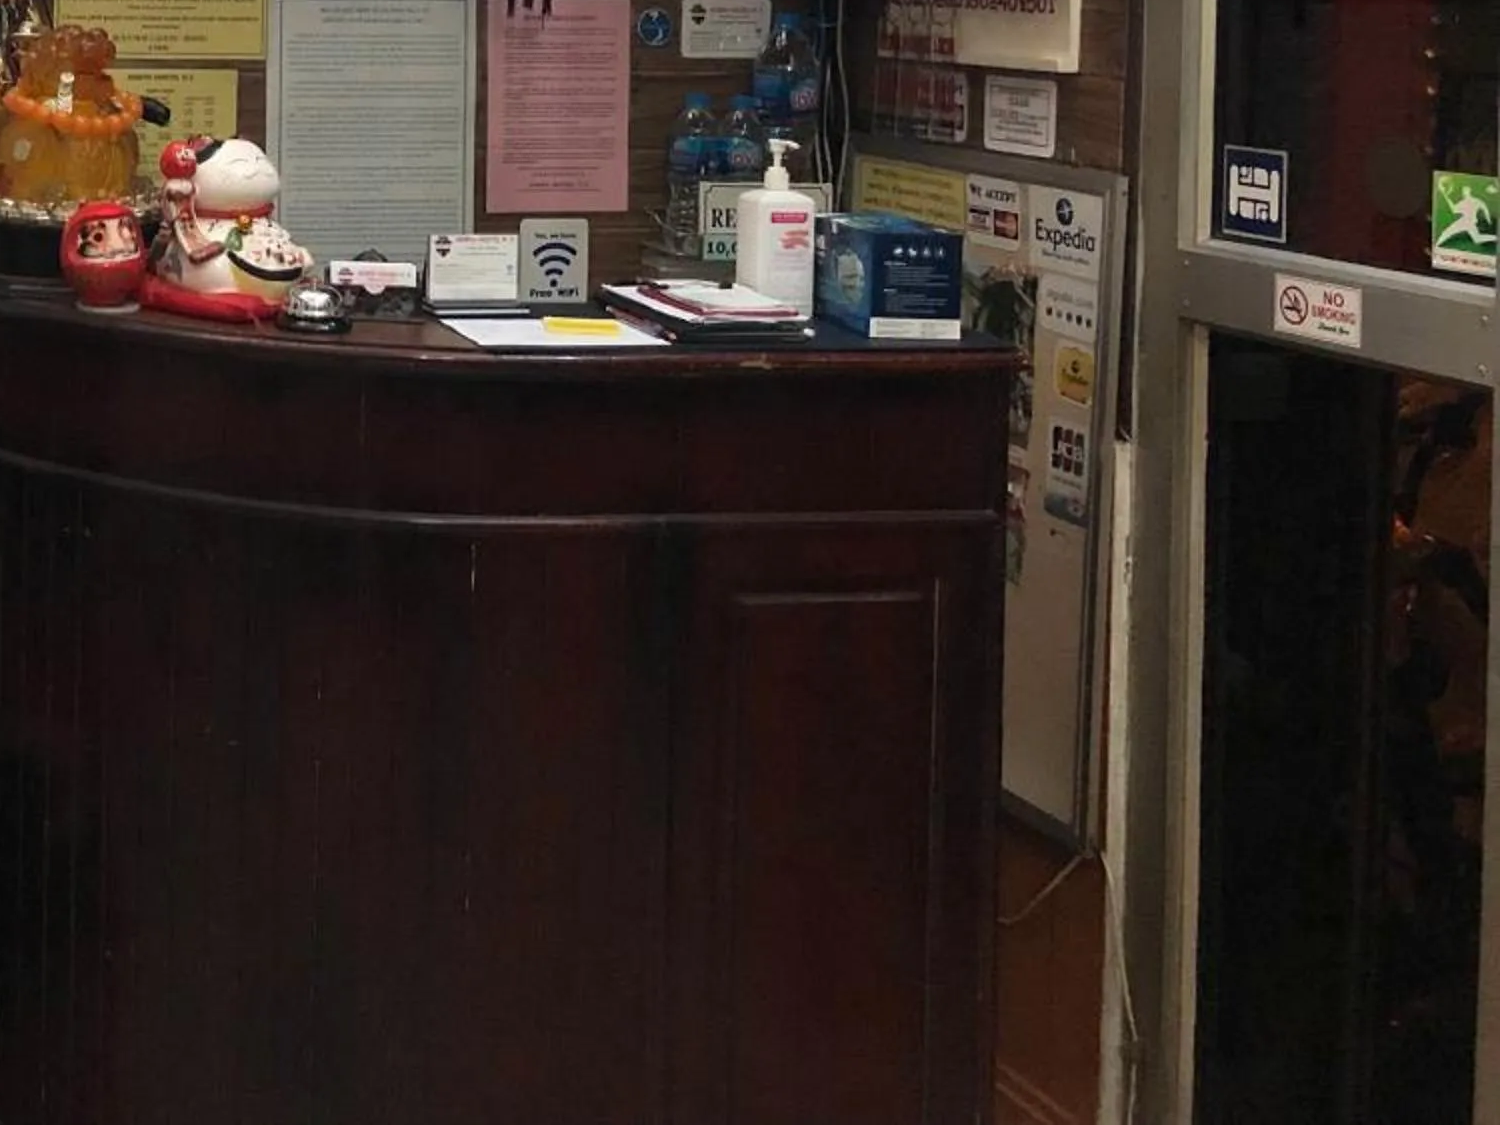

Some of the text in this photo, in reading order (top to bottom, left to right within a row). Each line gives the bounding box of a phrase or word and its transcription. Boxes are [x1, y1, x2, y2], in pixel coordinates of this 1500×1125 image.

[1034, 217, 1097, 253] Expedia
[1323, 290, 1345, 308] NO
[1311, 304, 1356, 325] SMOKING
